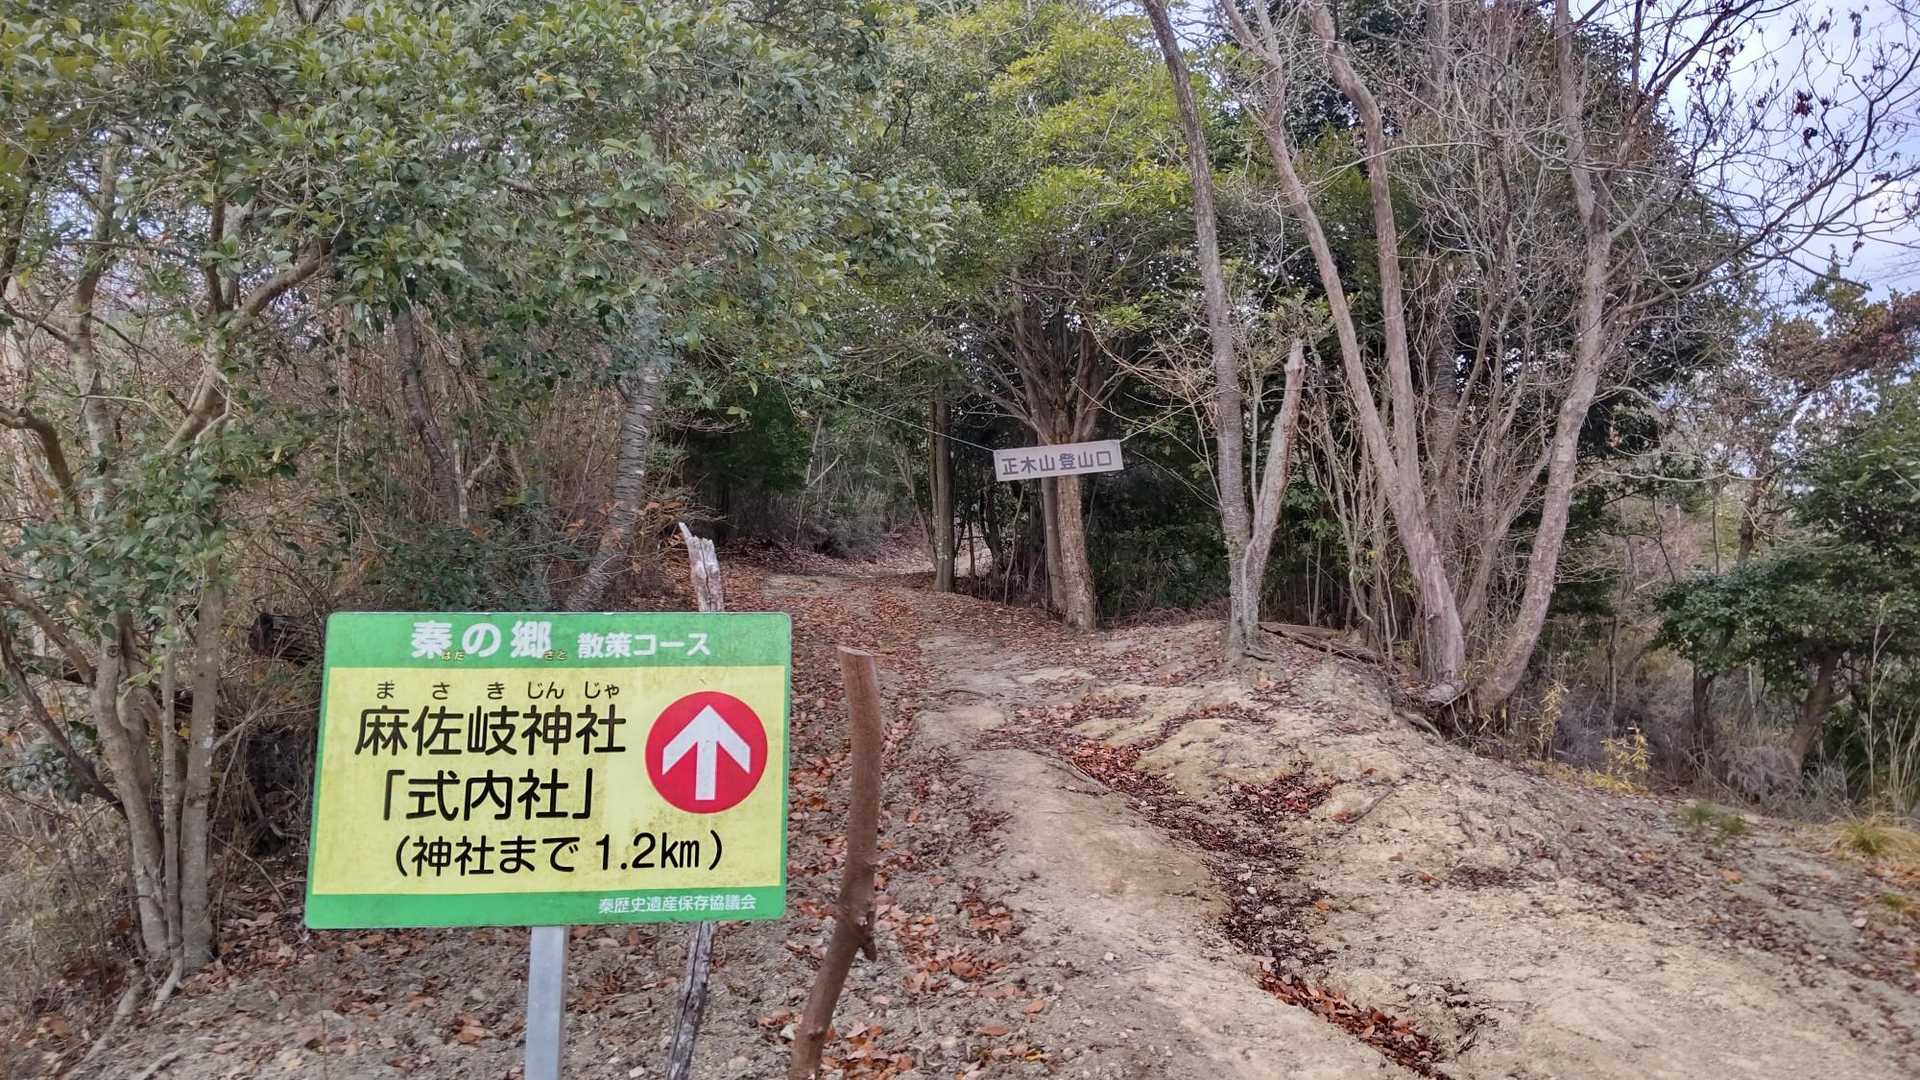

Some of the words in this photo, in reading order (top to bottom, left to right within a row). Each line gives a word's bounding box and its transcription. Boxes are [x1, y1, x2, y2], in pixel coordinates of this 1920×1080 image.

[1001, 451, 1112, 475] 正木山登山口
[411, 620, 551, 659] 秦の郷
[578, 631, 711, 658] 散策コース
[355, 704, 627, 756] 麻佐岐神社
[383, 768, 592, 821] 「式内社」
[598, 893, 757, 914] 秦歴史遺産保存協議会
